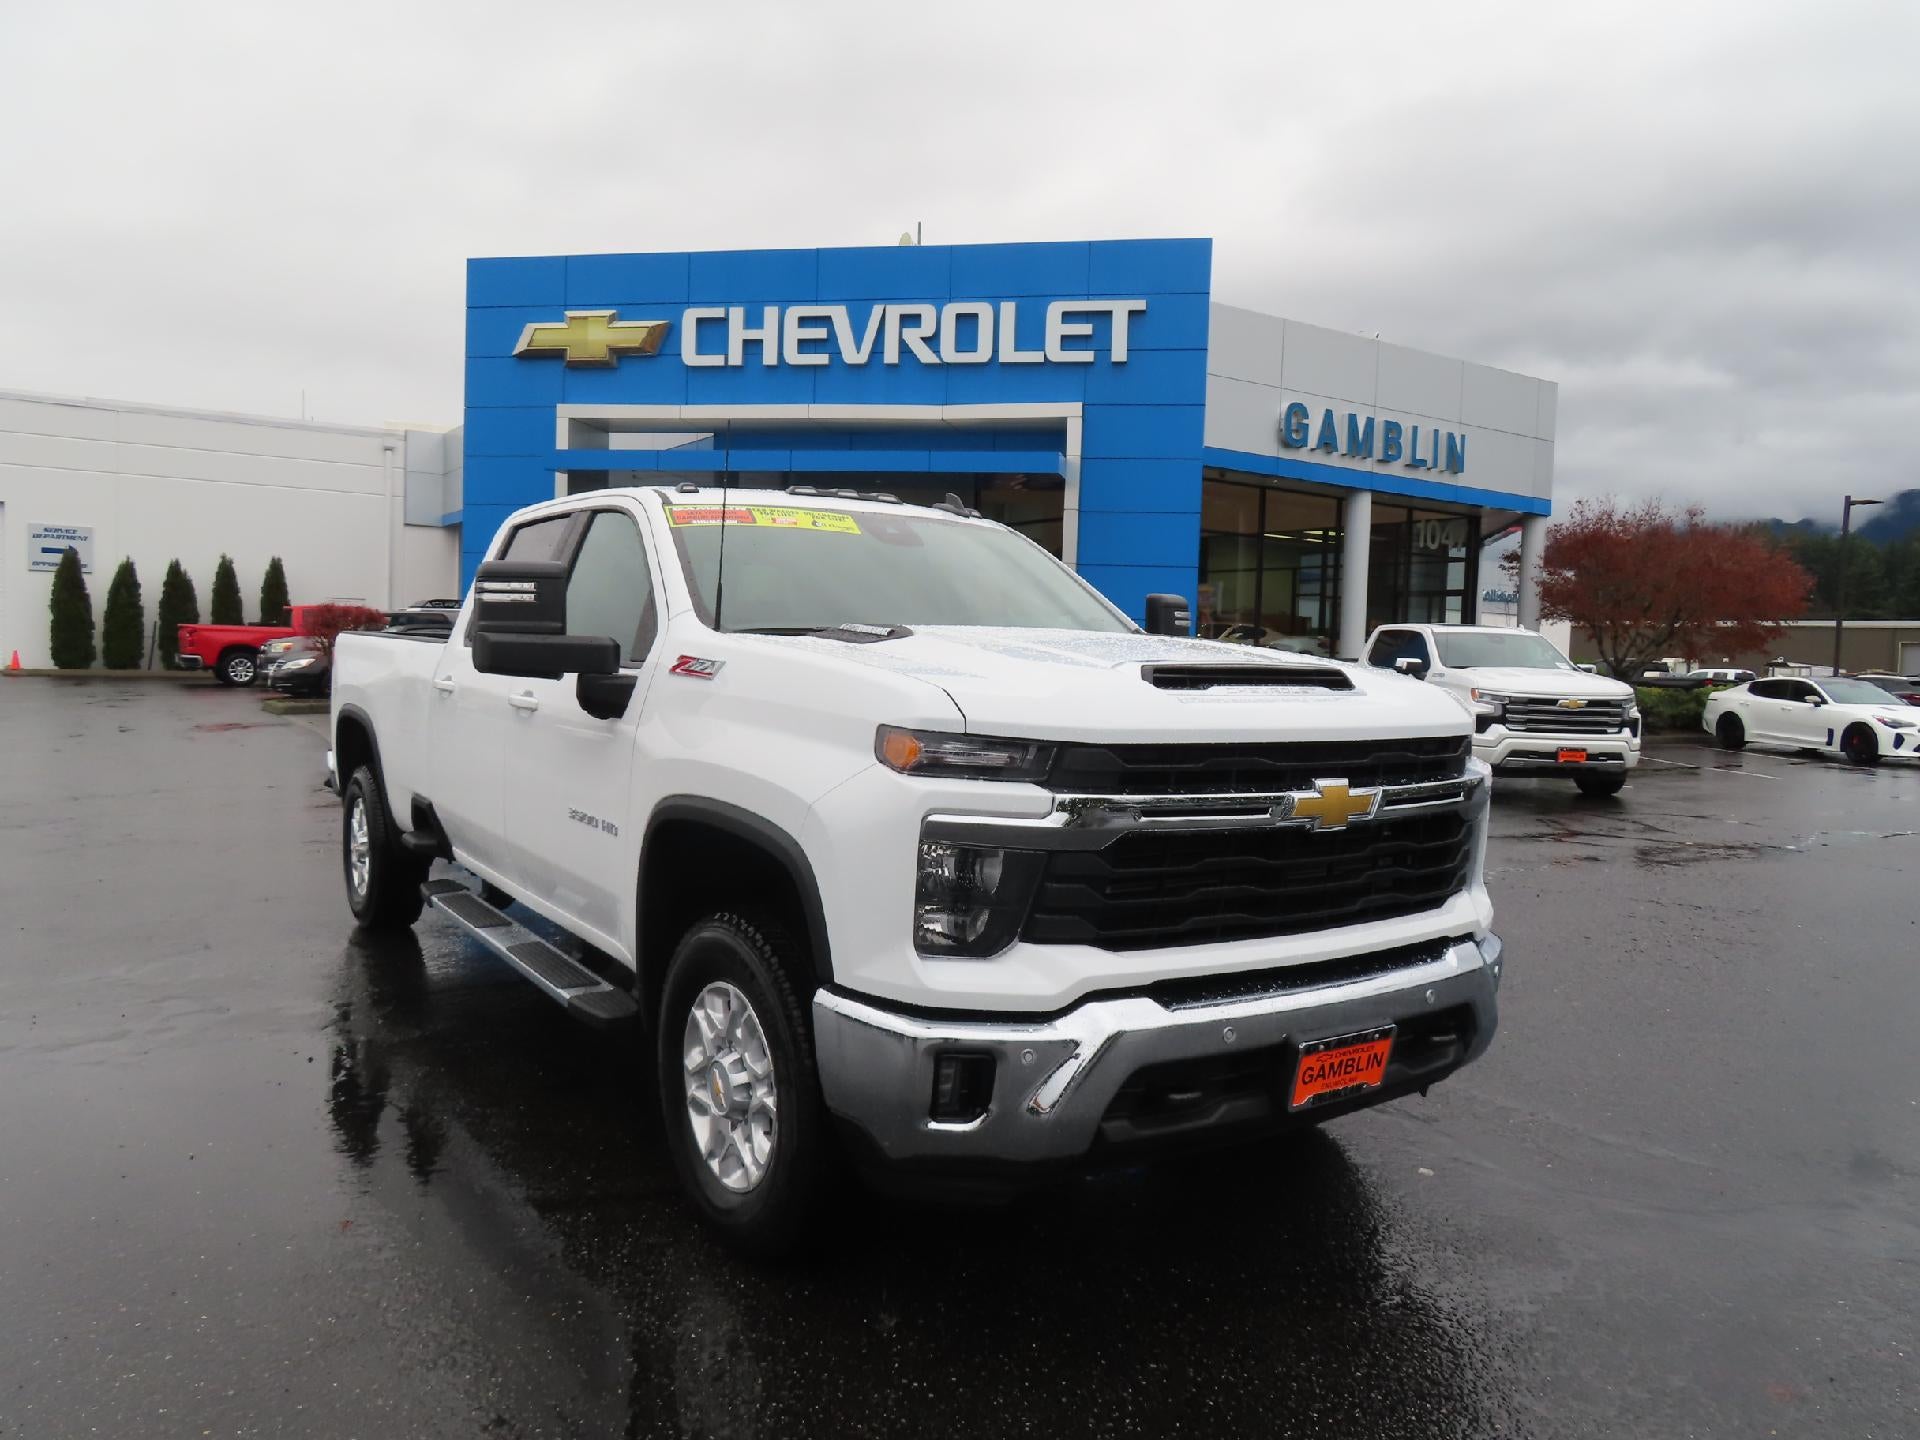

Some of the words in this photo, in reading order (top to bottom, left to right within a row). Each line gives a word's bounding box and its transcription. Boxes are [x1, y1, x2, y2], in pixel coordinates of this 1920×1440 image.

[681, 299, 1146, 368] CHEVROLET
[1281, 402, 1466, 474] GAMBLIN
[1301, 1052, 1384, 1085] GAMBLIN
